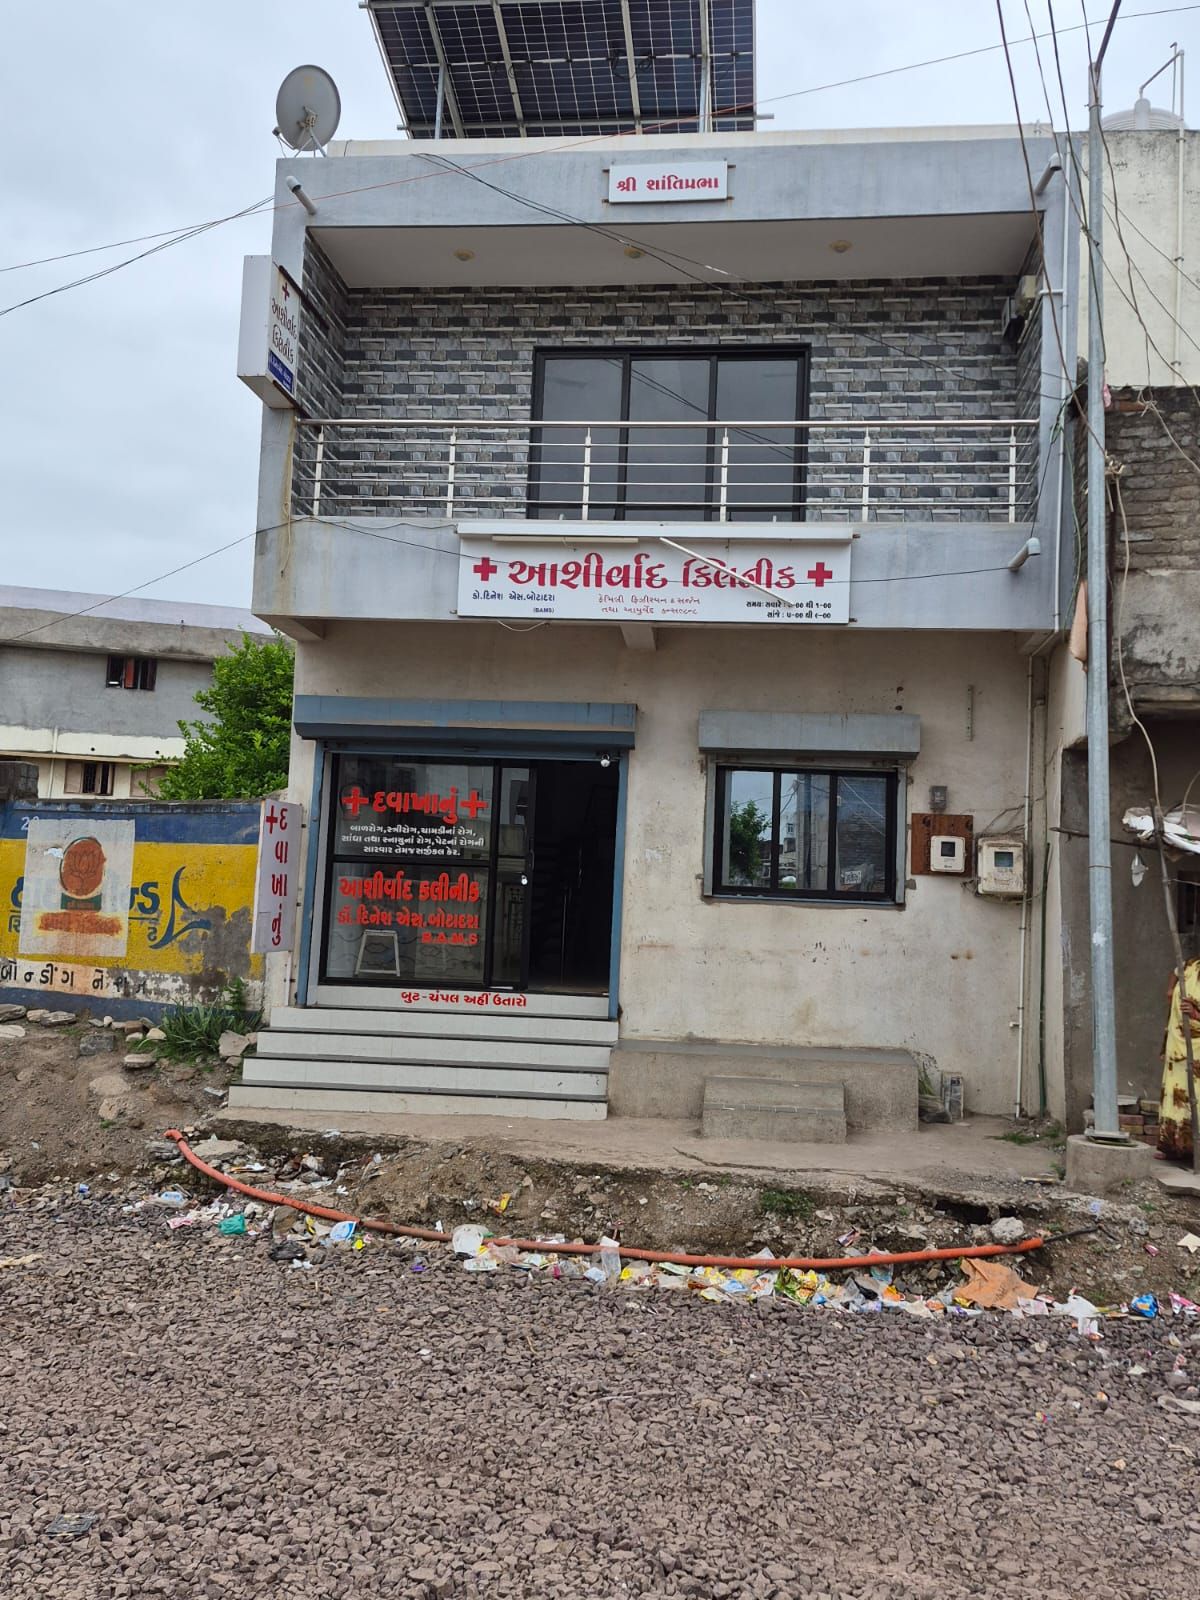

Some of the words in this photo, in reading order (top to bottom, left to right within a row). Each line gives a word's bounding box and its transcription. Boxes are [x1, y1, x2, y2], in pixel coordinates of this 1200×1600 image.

[615, 176, 637, 192] શ્રી
[646, 174, 719, 191] શાંતિપ્રભા
[508, 552, 668, 590] આશીર્વાદ
[372, 786, 459, 825] દવાખાનું
[363, 835, 381, 843] તથા
[338, 870, 413, 900] આશીર્વાદ
[492, 992, 527, 1007] ઉતારો
